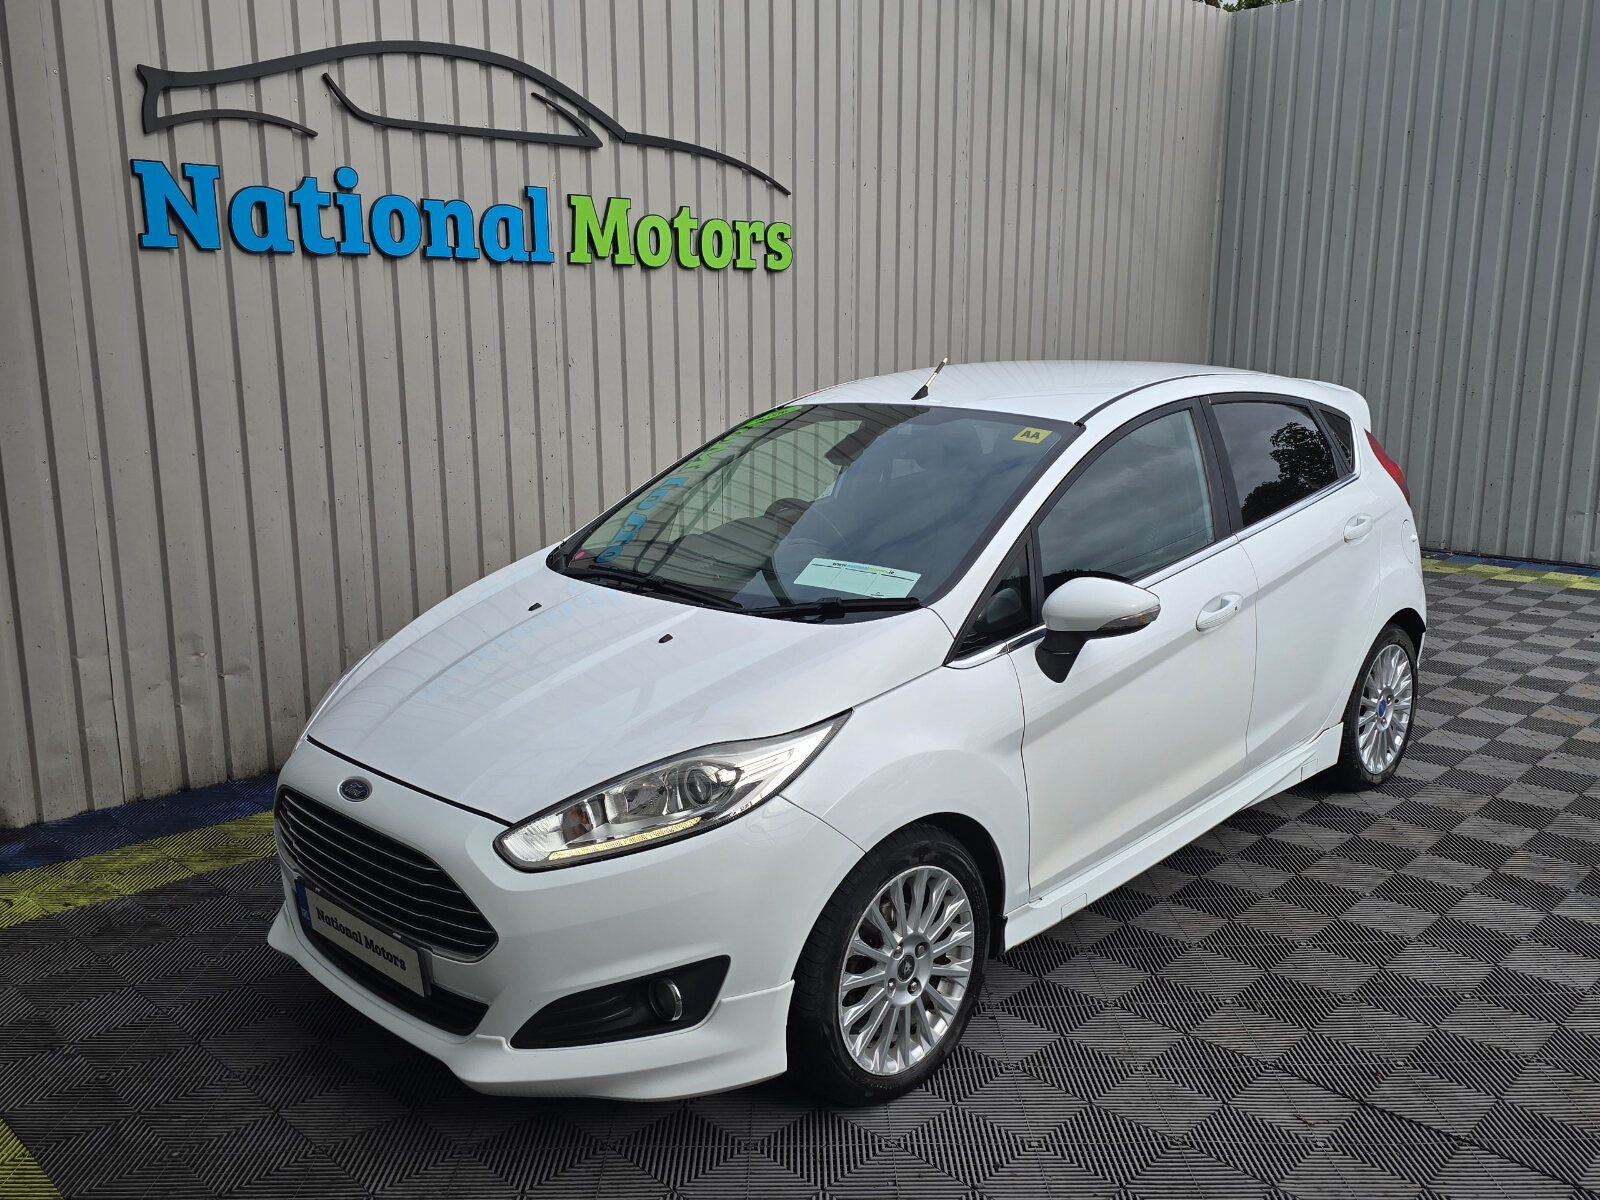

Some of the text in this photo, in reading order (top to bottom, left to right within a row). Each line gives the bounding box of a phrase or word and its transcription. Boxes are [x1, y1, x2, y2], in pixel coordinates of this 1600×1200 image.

[132, 160, 792, 271] National Motors
[1020, 430, 1040, 440] AA
[316, 907, 407, 971] National Motors
